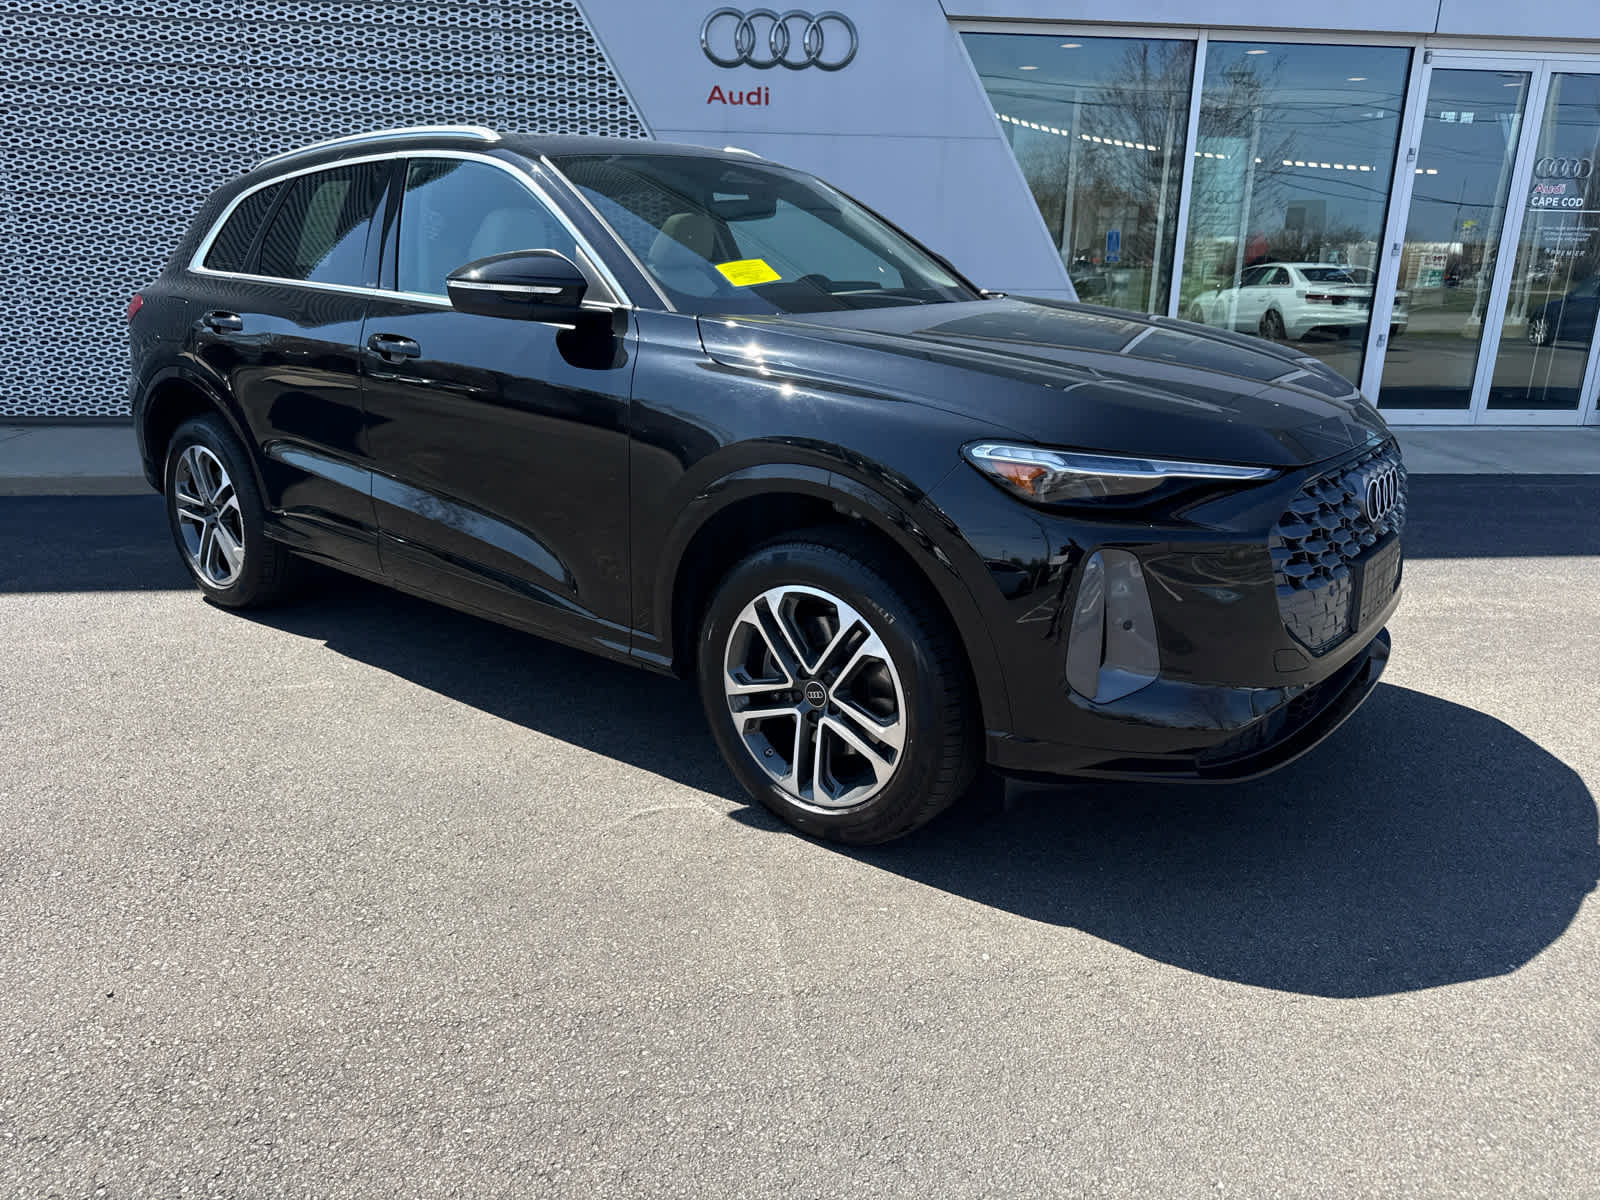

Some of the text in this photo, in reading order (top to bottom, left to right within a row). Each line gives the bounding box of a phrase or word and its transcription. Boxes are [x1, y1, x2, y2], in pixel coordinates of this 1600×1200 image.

[706, 85, 769, 105] Audi
[1533, 184, 1566, 194] Audi
[1531, 197, 1584, 207] CAPE COD
